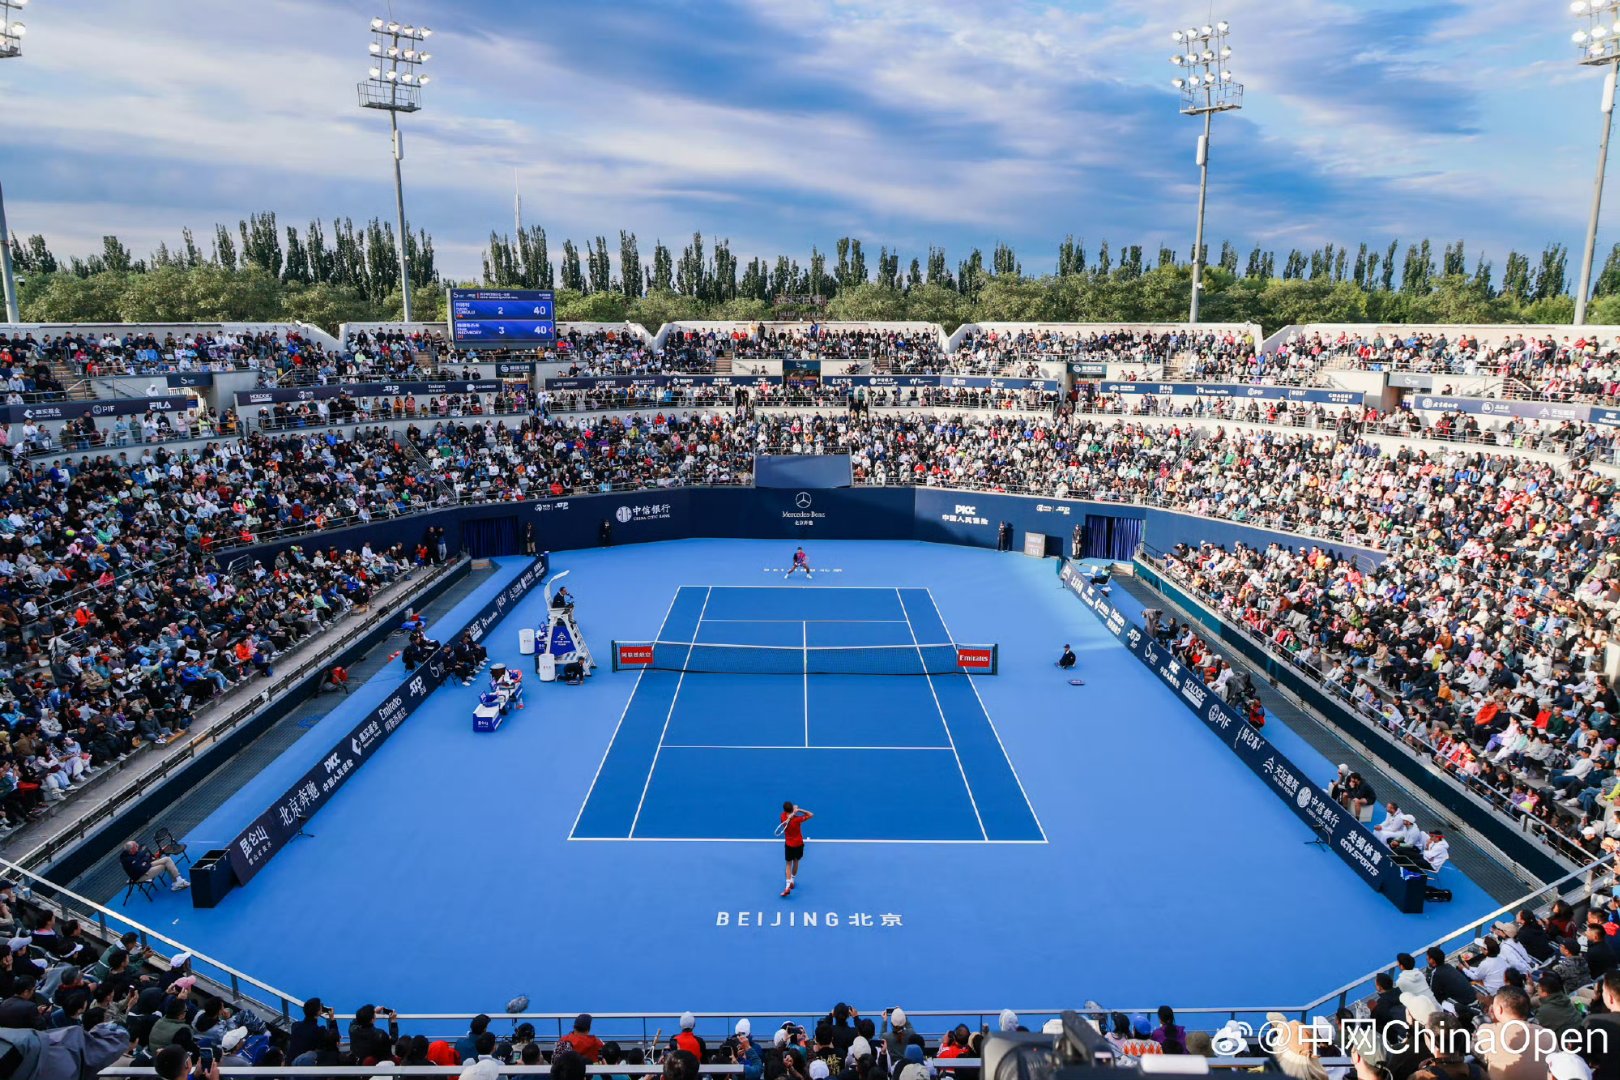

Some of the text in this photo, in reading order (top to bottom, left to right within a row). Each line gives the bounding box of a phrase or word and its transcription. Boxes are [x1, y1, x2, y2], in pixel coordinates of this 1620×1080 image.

[498, 306, 546, 315] 2 40
[498, 326, 547, 334] 3 40
[102, 405, 116, 413] PIF
[149, 401, 172, 410] FILA
[632, 504, 671, 516] 中信银行
[782, 510, 826, 518] Mercedes-Benz
[955, 504, 976, 515] PICC
[1184, 677, 1208, 702] HOLOGIC
[378, 696, 403, 721] Emirates
[1215, 711, 1232, 730] PIF
[324, 752, 341, 774] PICC
[279, 780, 320, 826] 北京奔驰
[1310, 796, 1340, 828] 中信银行
[239, 825, 269, 859] 昆仑山
[1347, 829, 1383, 866] 央视体育
[1339, 838, 1380, 877] CCTV SPORTS
[716, 911, 904, 927] BEIJING 北京
